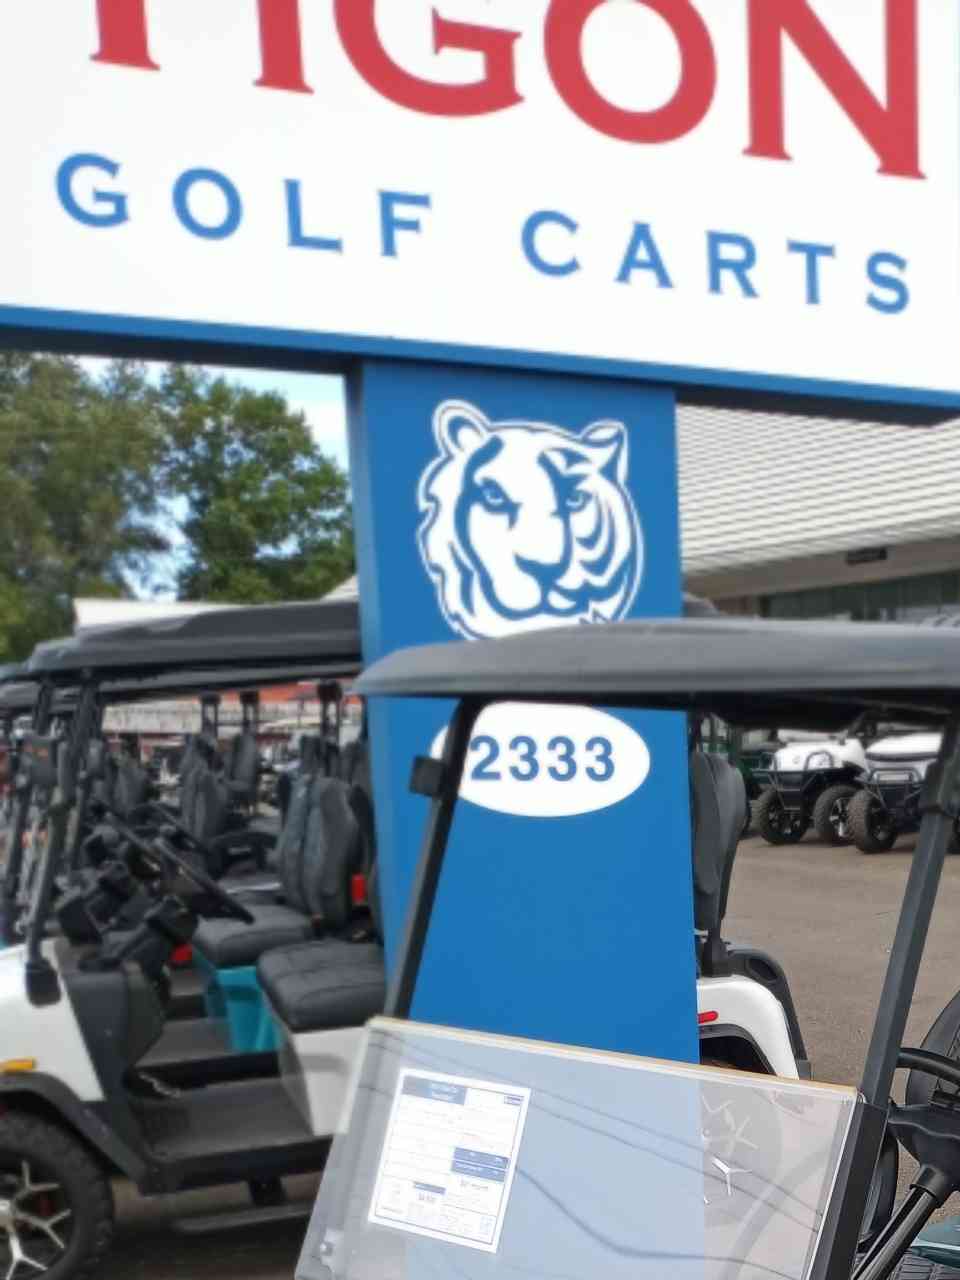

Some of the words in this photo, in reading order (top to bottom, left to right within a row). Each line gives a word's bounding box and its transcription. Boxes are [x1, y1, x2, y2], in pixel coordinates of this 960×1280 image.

[54, 151, 433, 258] GOLF
[519, 209, 912, 315] CARTS
[470, 735, 616, 782] 2333
